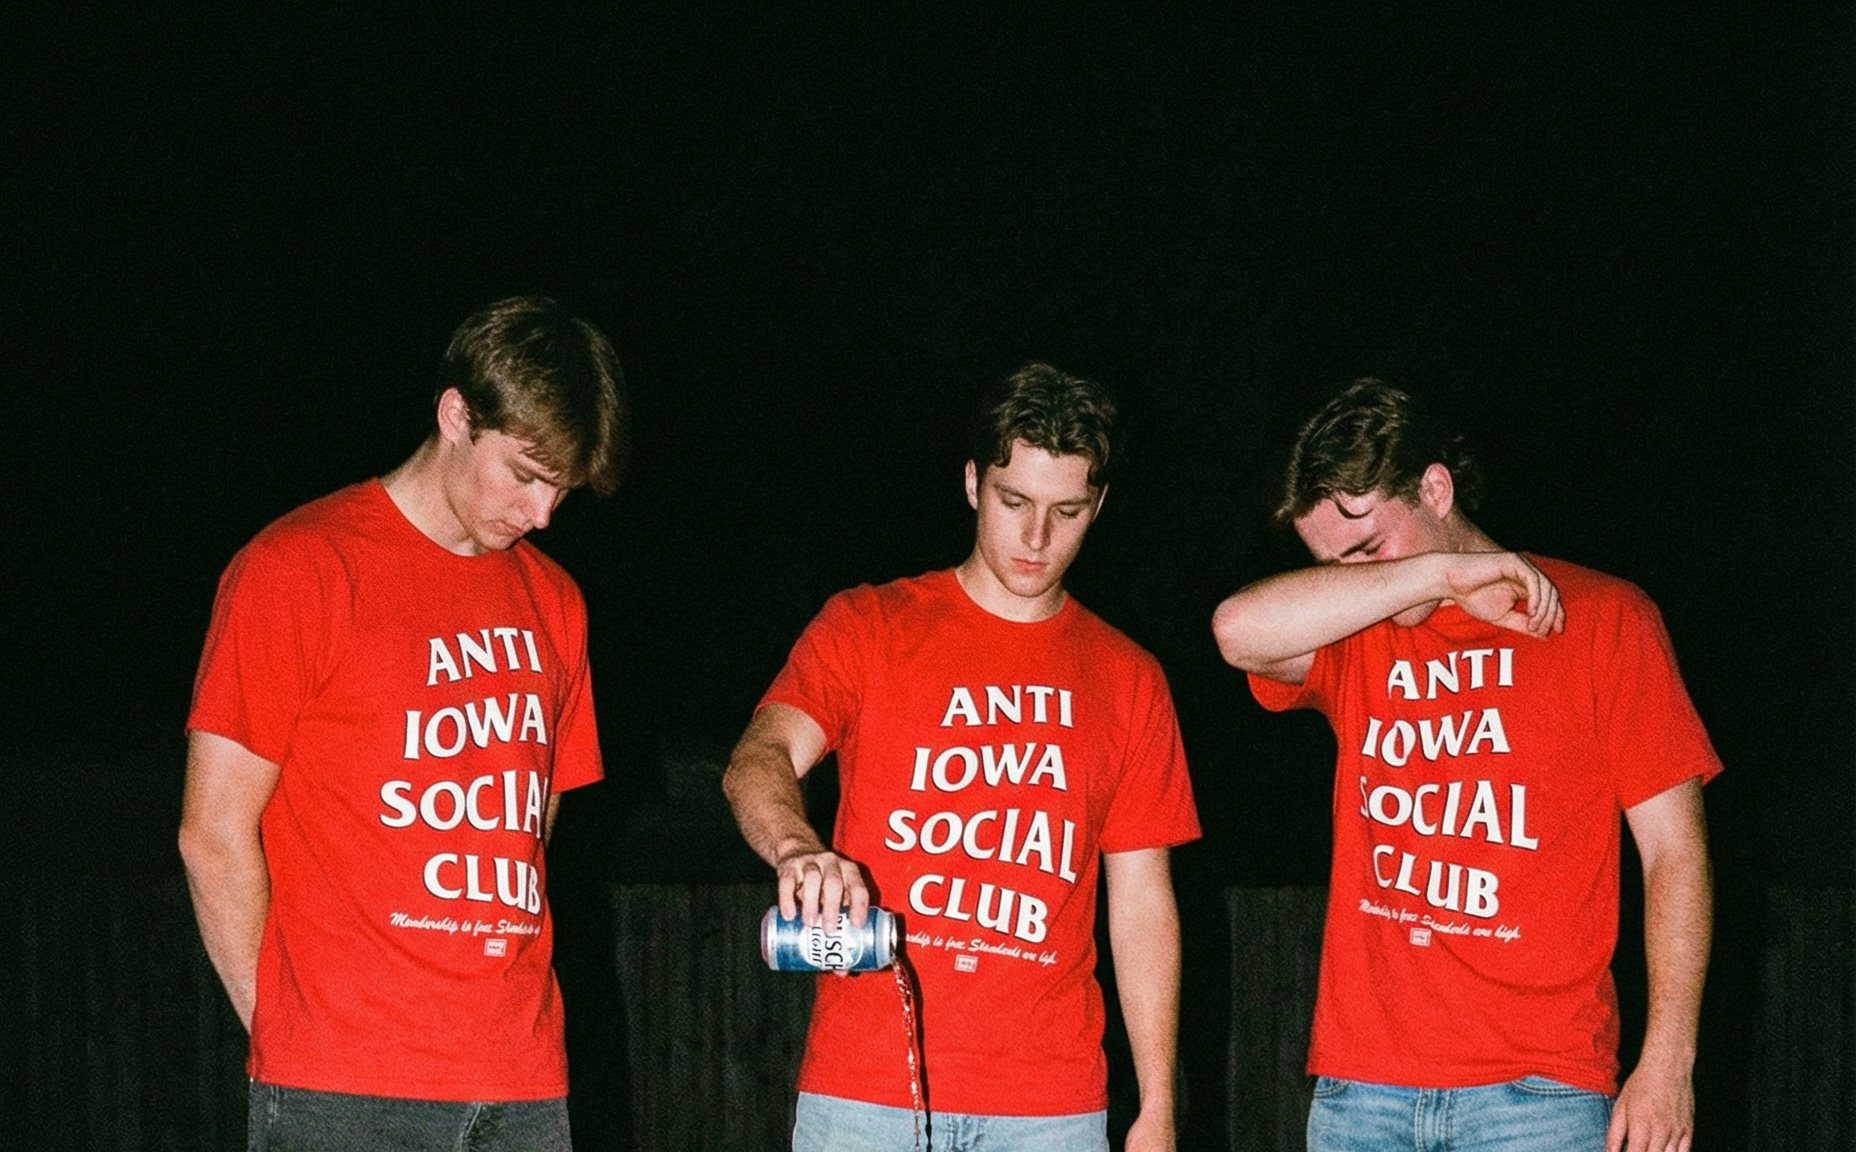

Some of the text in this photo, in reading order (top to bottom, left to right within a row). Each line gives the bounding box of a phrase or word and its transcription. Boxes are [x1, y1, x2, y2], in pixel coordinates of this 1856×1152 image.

[426, 626, 543, 686] ANTI
[1387, 647, 1515, 700] ANTI
[403, 692, 548, 760] IOWA
[940, 684, 1074, 728] ANTI
[910, 742, 1068, 792] IOWA
[1361, 707, 1511, 767] IOWA
[884, 808, 1076, 884] SOCIAL
[423, 852, 541, 915] CLUB
[908, 872, 1049, 944] CLUB
[1372, 844, 1500, 919] CLUB
